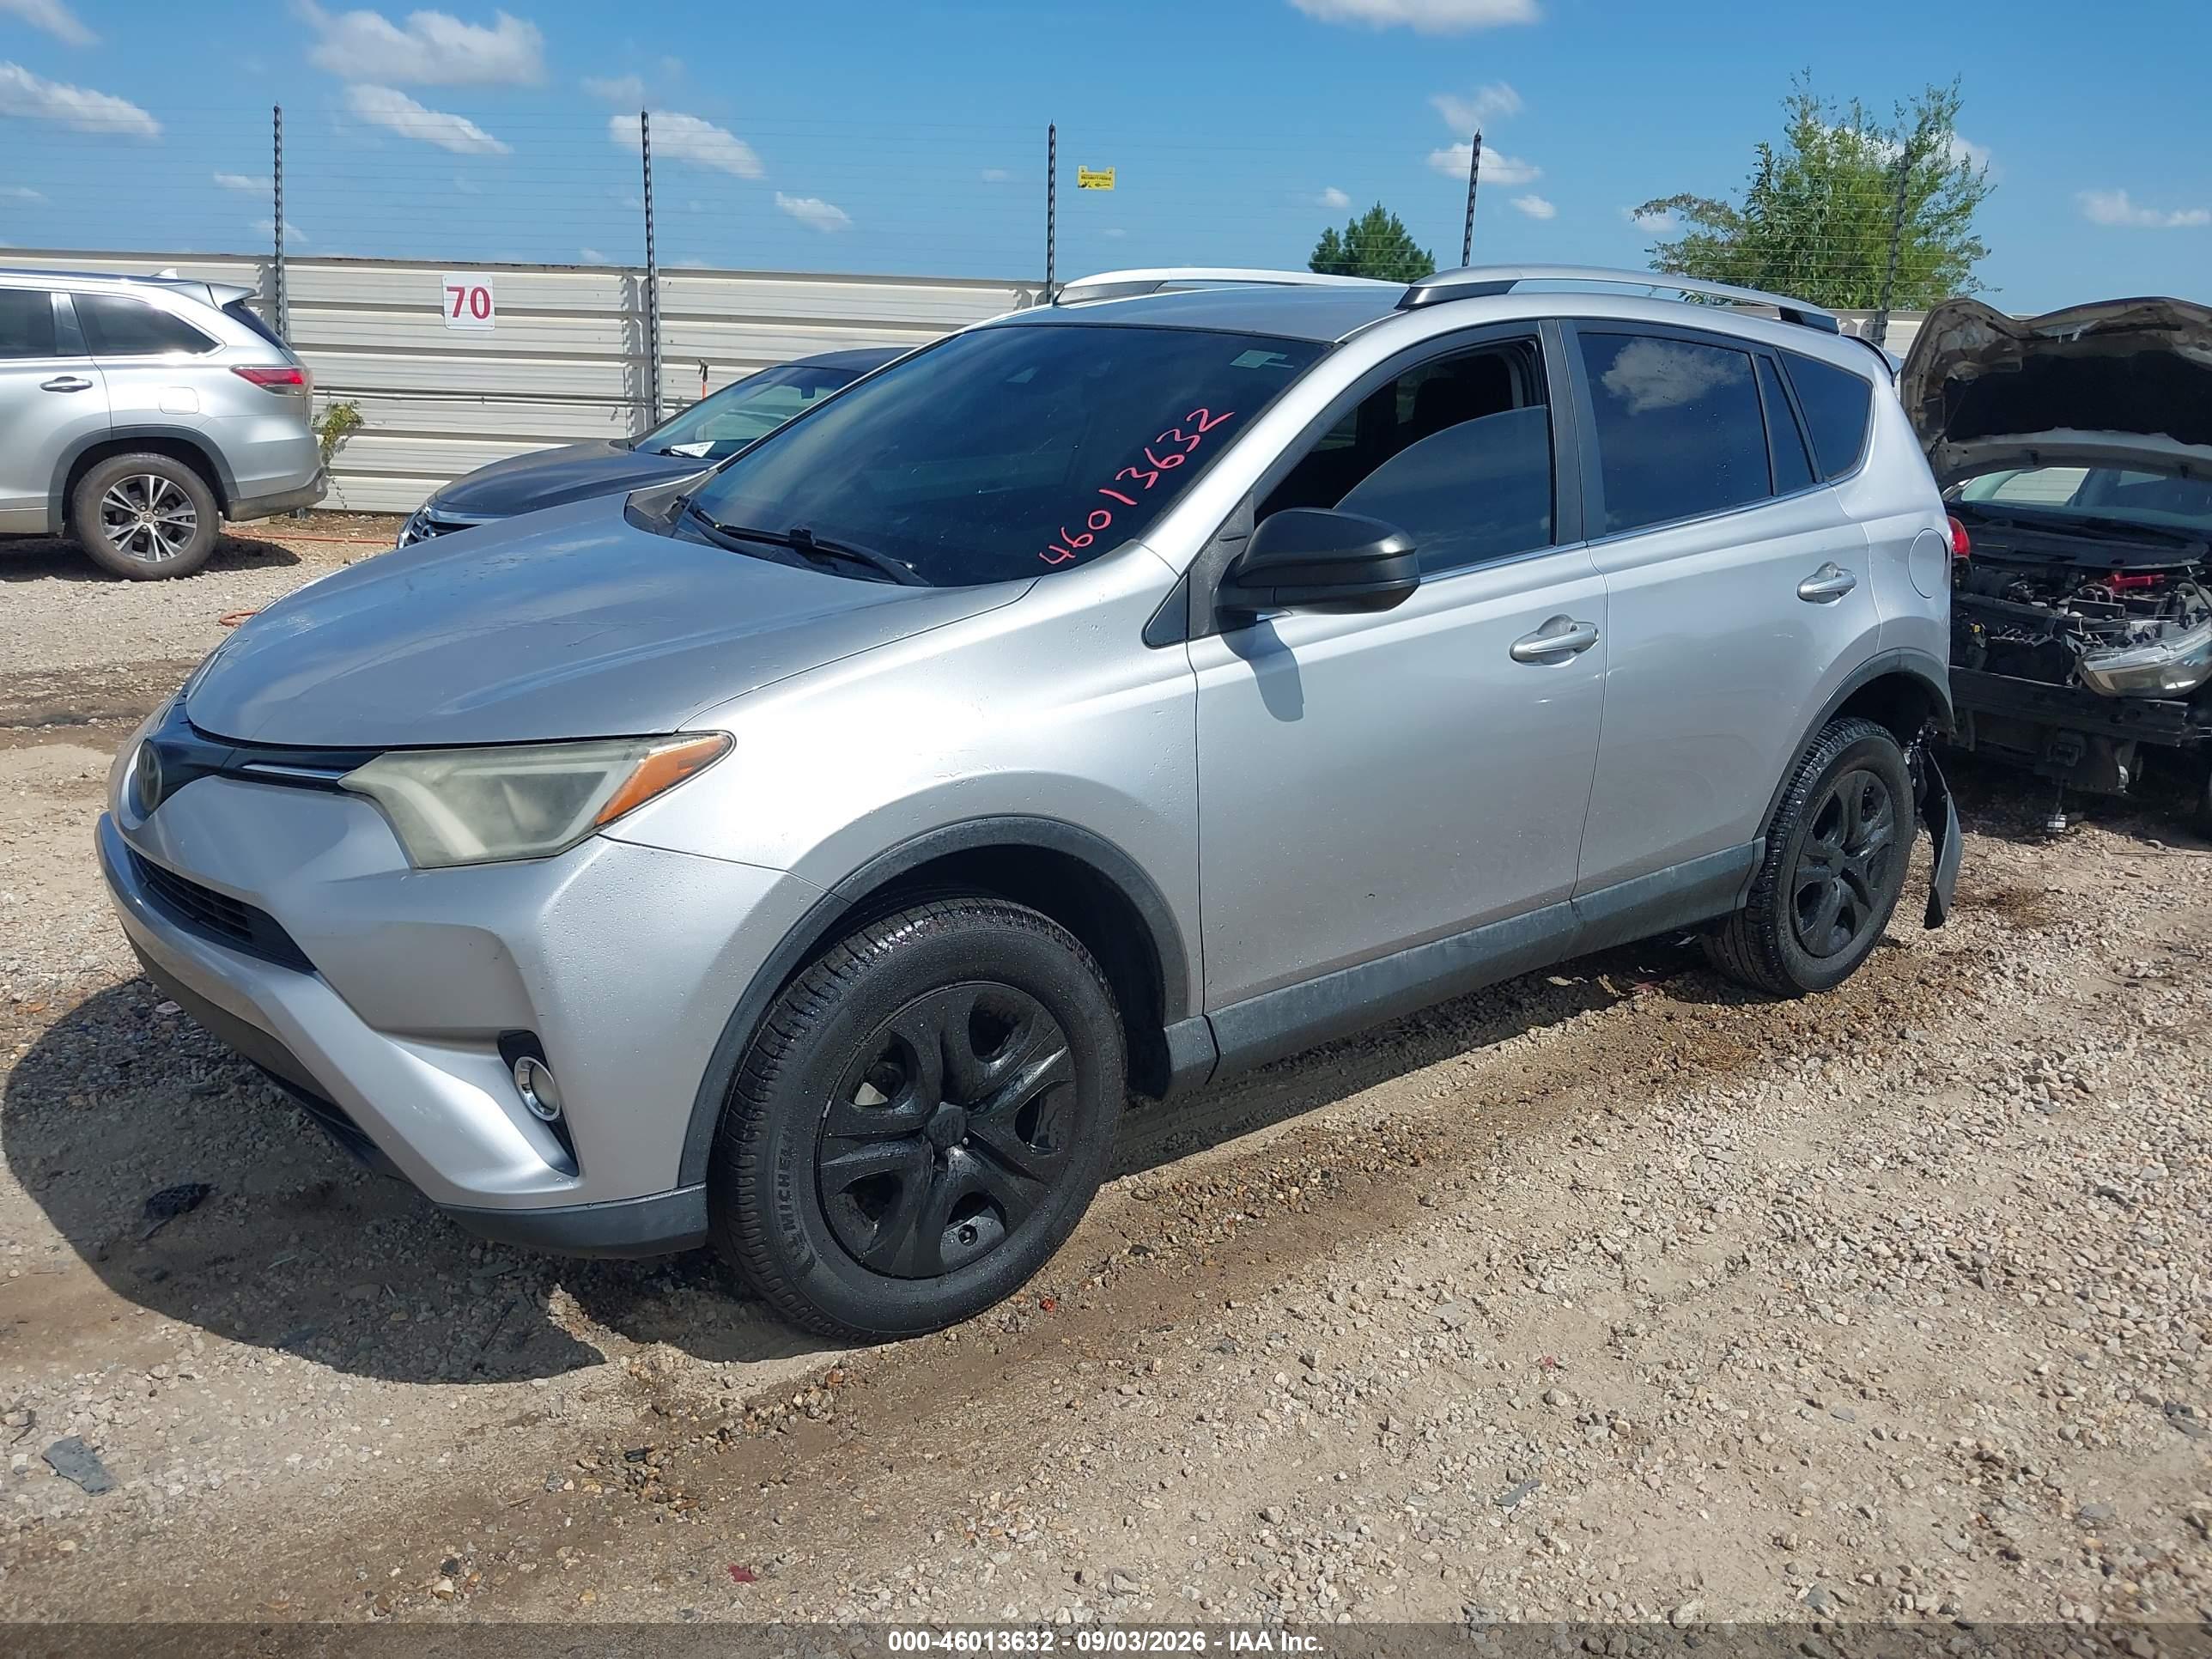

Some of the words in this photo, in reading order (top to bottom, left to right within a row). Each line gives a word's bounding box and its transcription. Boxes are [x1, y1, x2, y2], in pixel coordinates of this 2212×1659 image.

[446, 286, 491, 319] 70
[1039, 408, 1235, 565] 46013632
[776, 1126, 797, 1231] MICHE
